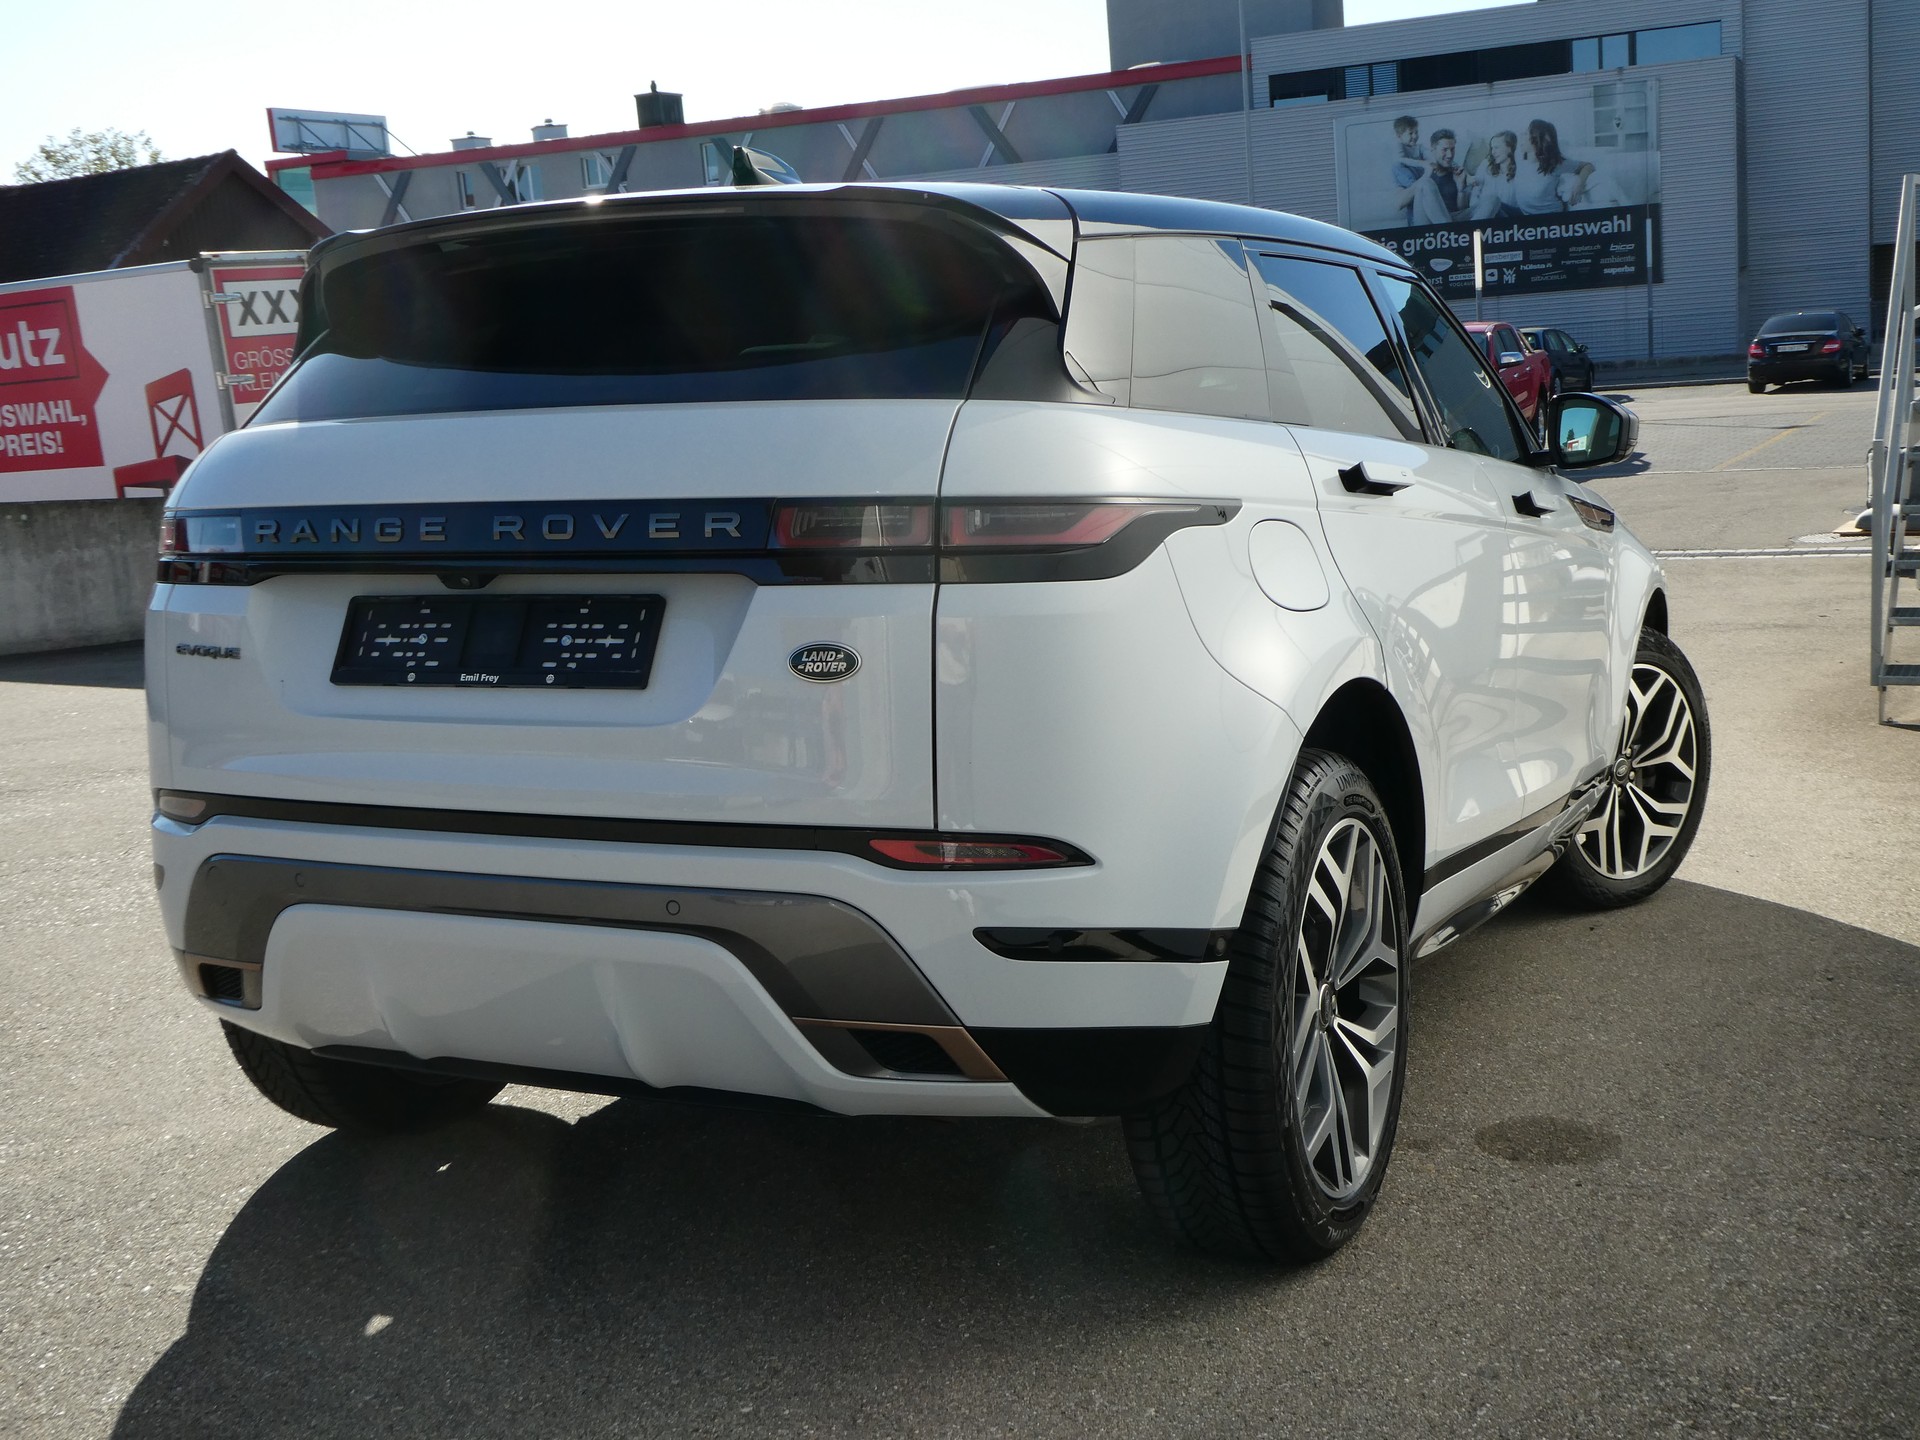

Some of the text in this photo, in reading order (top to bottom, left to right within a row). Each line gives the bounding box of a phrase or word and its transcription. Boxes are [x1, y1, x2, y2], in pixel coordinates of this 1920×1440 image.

[1381, 215, 1632, 256] ie größte Markenauswahl
[0, 400, 87, 428] SWAHL,
[254, 512, 742, 543] RANGE ROVER
[802, 651, 837, 661] LAND
[805, 662, 847, 672] ROVER
[460, 673, 499, 683] Emil Frey
